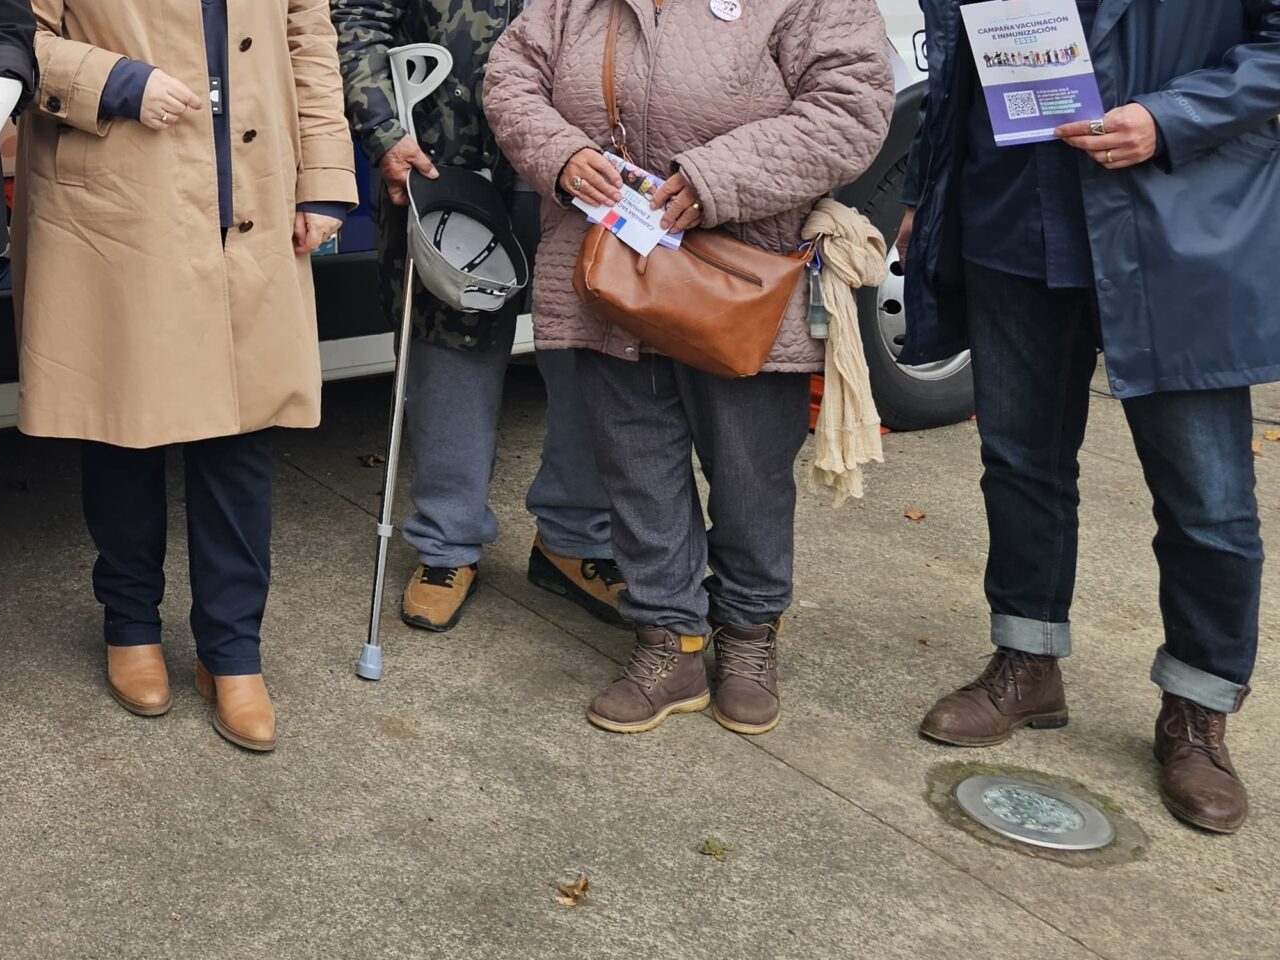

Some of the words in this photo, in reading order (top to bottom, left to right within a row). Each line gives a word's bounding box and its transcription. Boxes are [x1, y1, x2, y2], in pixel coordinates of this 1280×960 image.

[977, 24, 1015, 35] CAMPAÑA
[1015, 15, 1069, 31] VACUNACIÓN
[997, 25, 1058, 40] INMUNIZACIÓN
